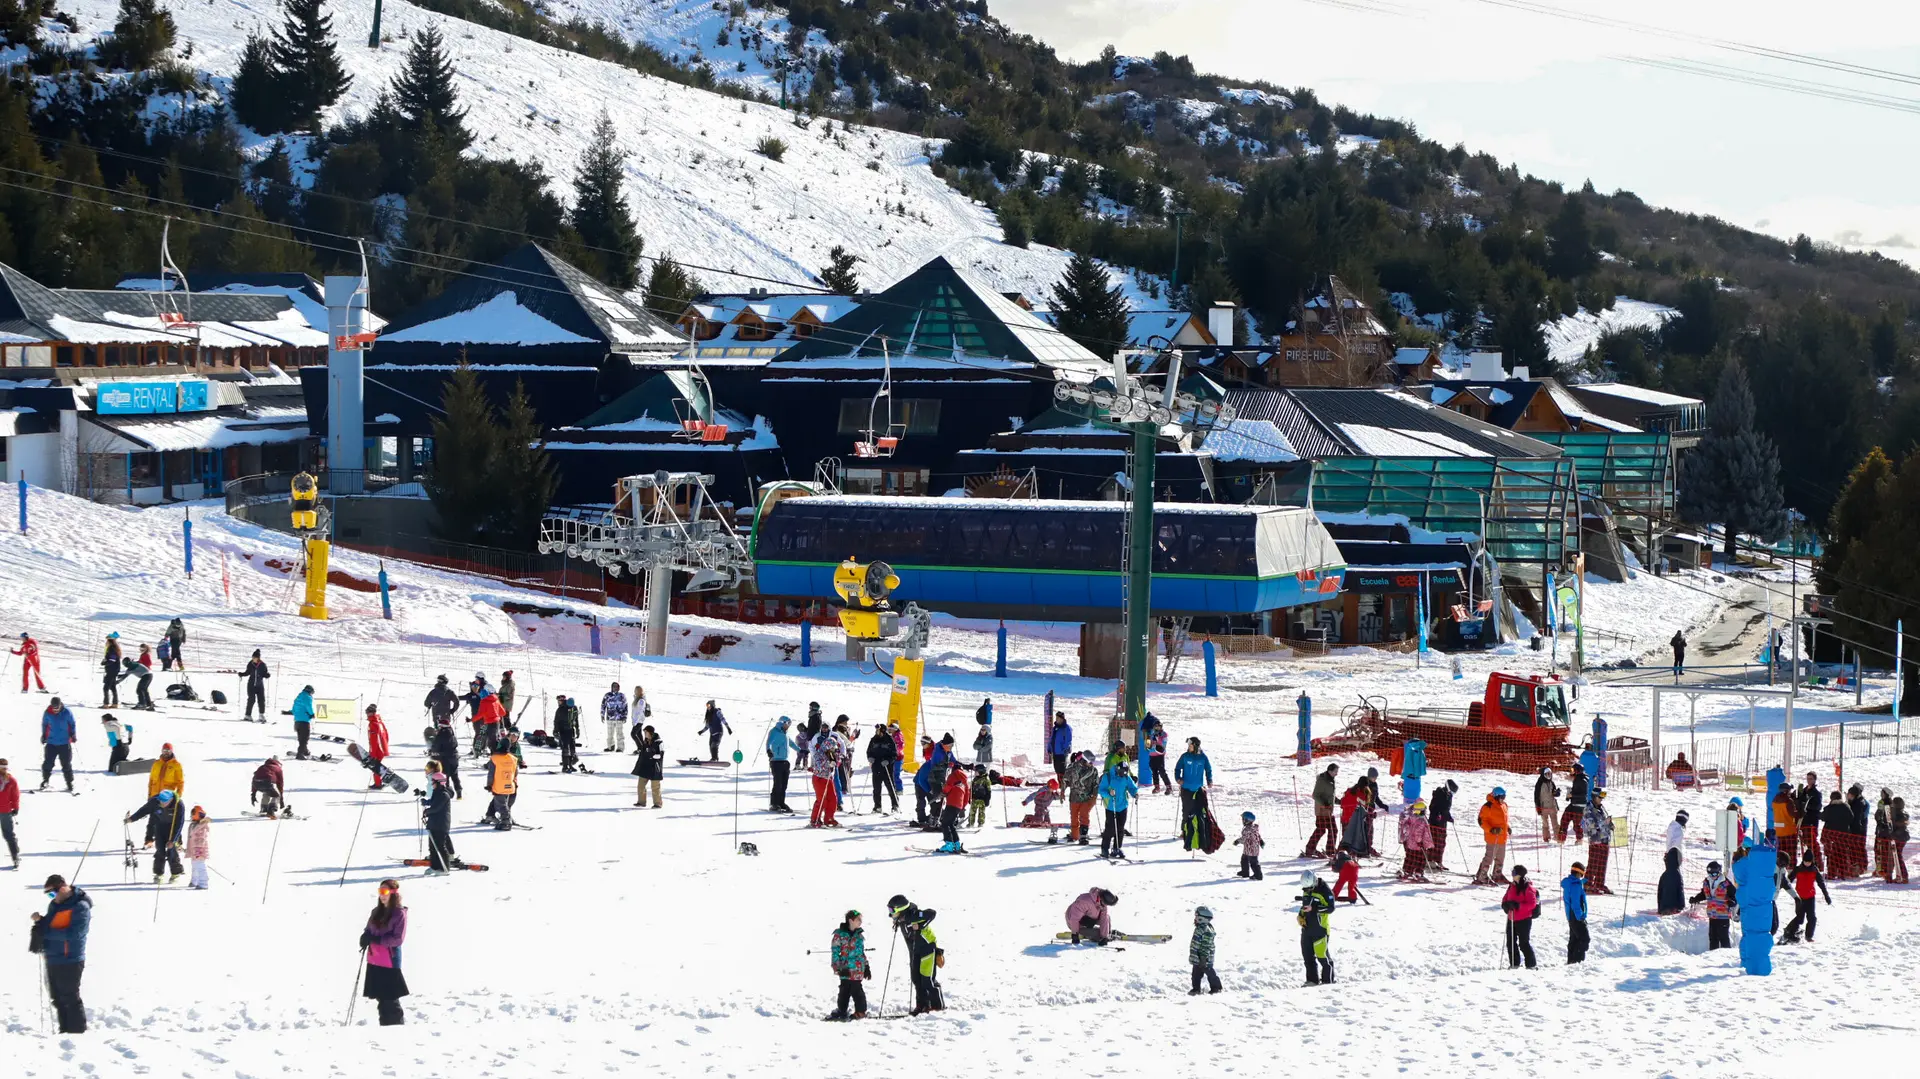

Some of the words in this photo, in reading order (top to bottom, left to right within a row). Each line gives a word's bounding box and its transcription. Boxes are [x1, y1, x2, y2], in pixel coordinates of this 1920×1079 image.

[133, 387, 174, 409] RENTAL
[1360, 577, 1390, 586] Escuela
[1432, 575, 1456, 584] Rental
